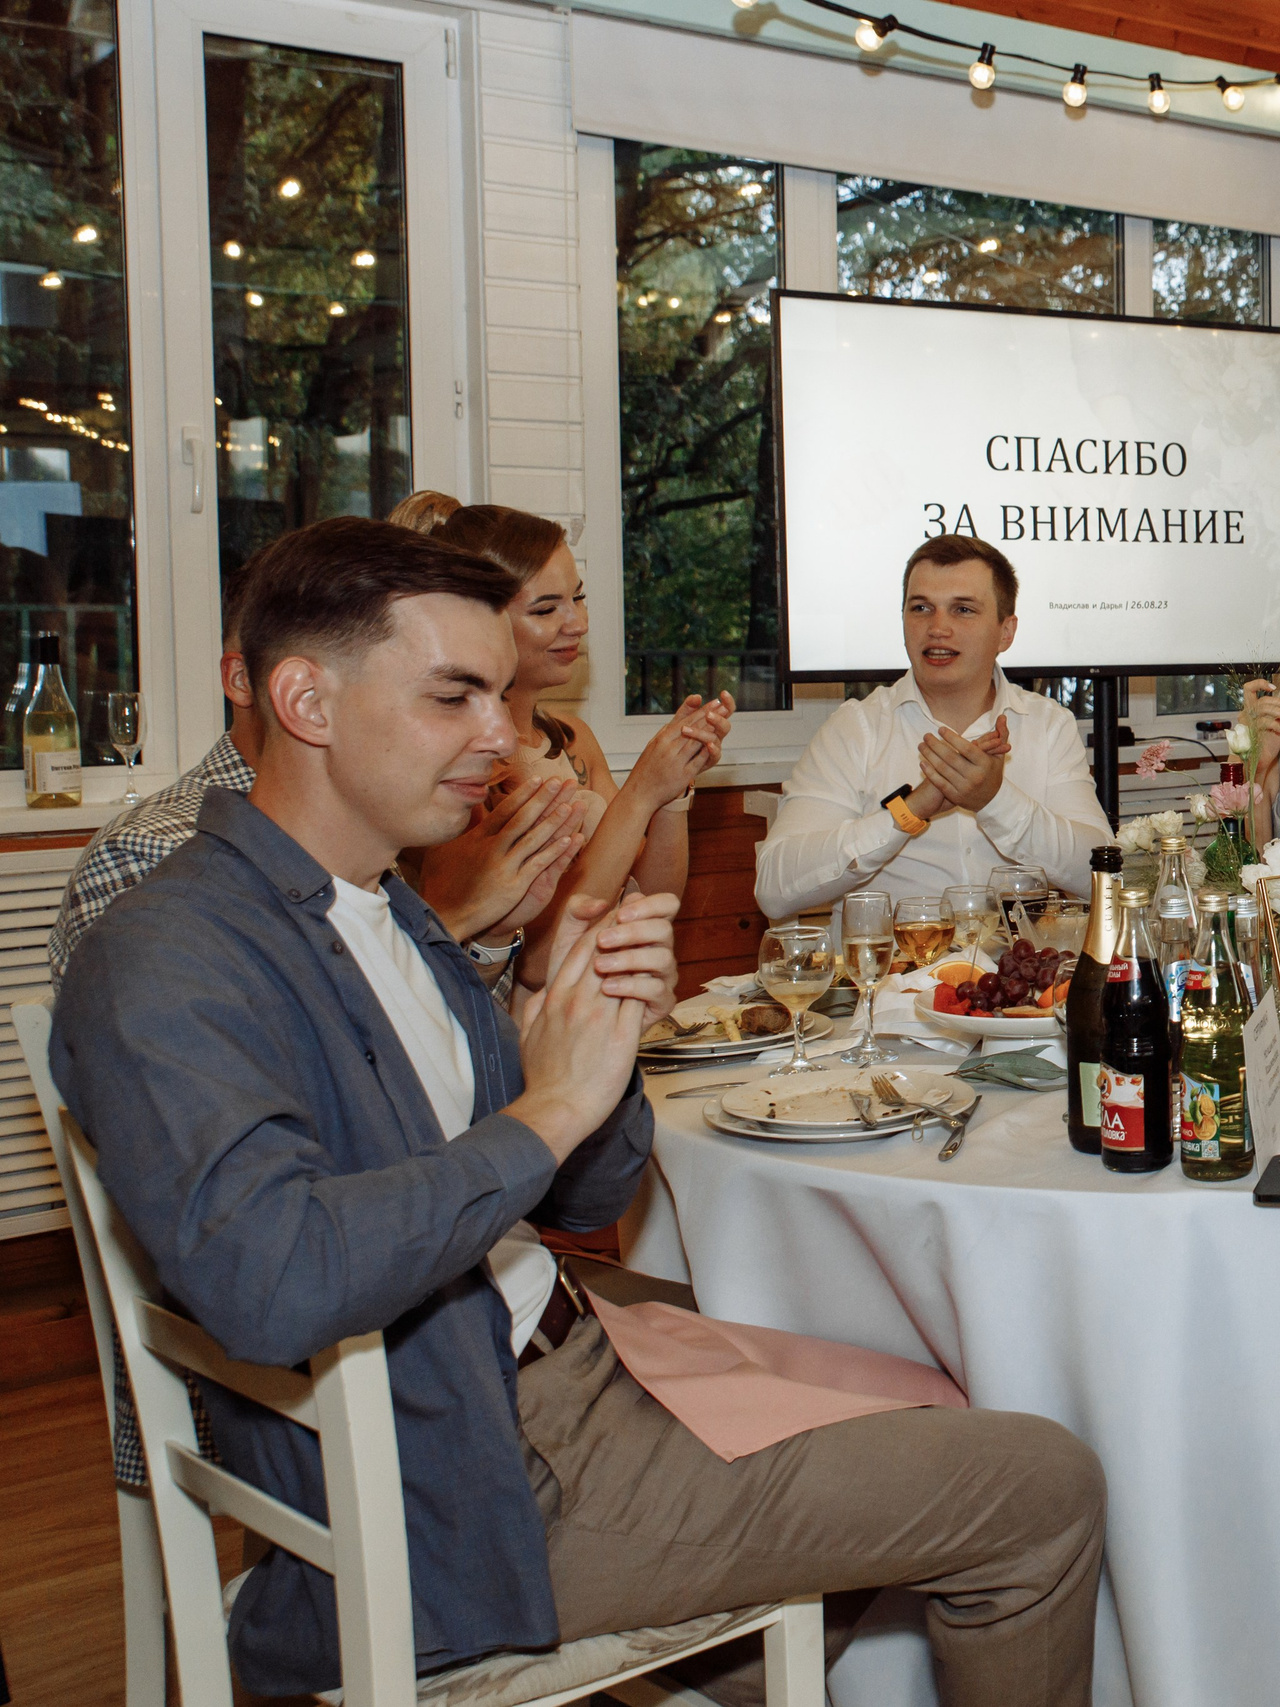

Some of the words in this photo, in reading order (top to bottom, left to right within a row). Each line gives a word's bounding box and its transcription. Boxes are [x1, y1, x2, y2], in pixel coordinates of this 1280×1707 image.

[986, 435, 1187, 477] СПАСИБО
[923, 503, 979, 538] ЗА
[1000, 505, 1244, 544] ВНИМАНИЕ
[1049, 602, 1089, 610] Владислав
[1099, 602, 1123, 610] Дарья
[1130, 600, 1168, 610] 26.08.23
